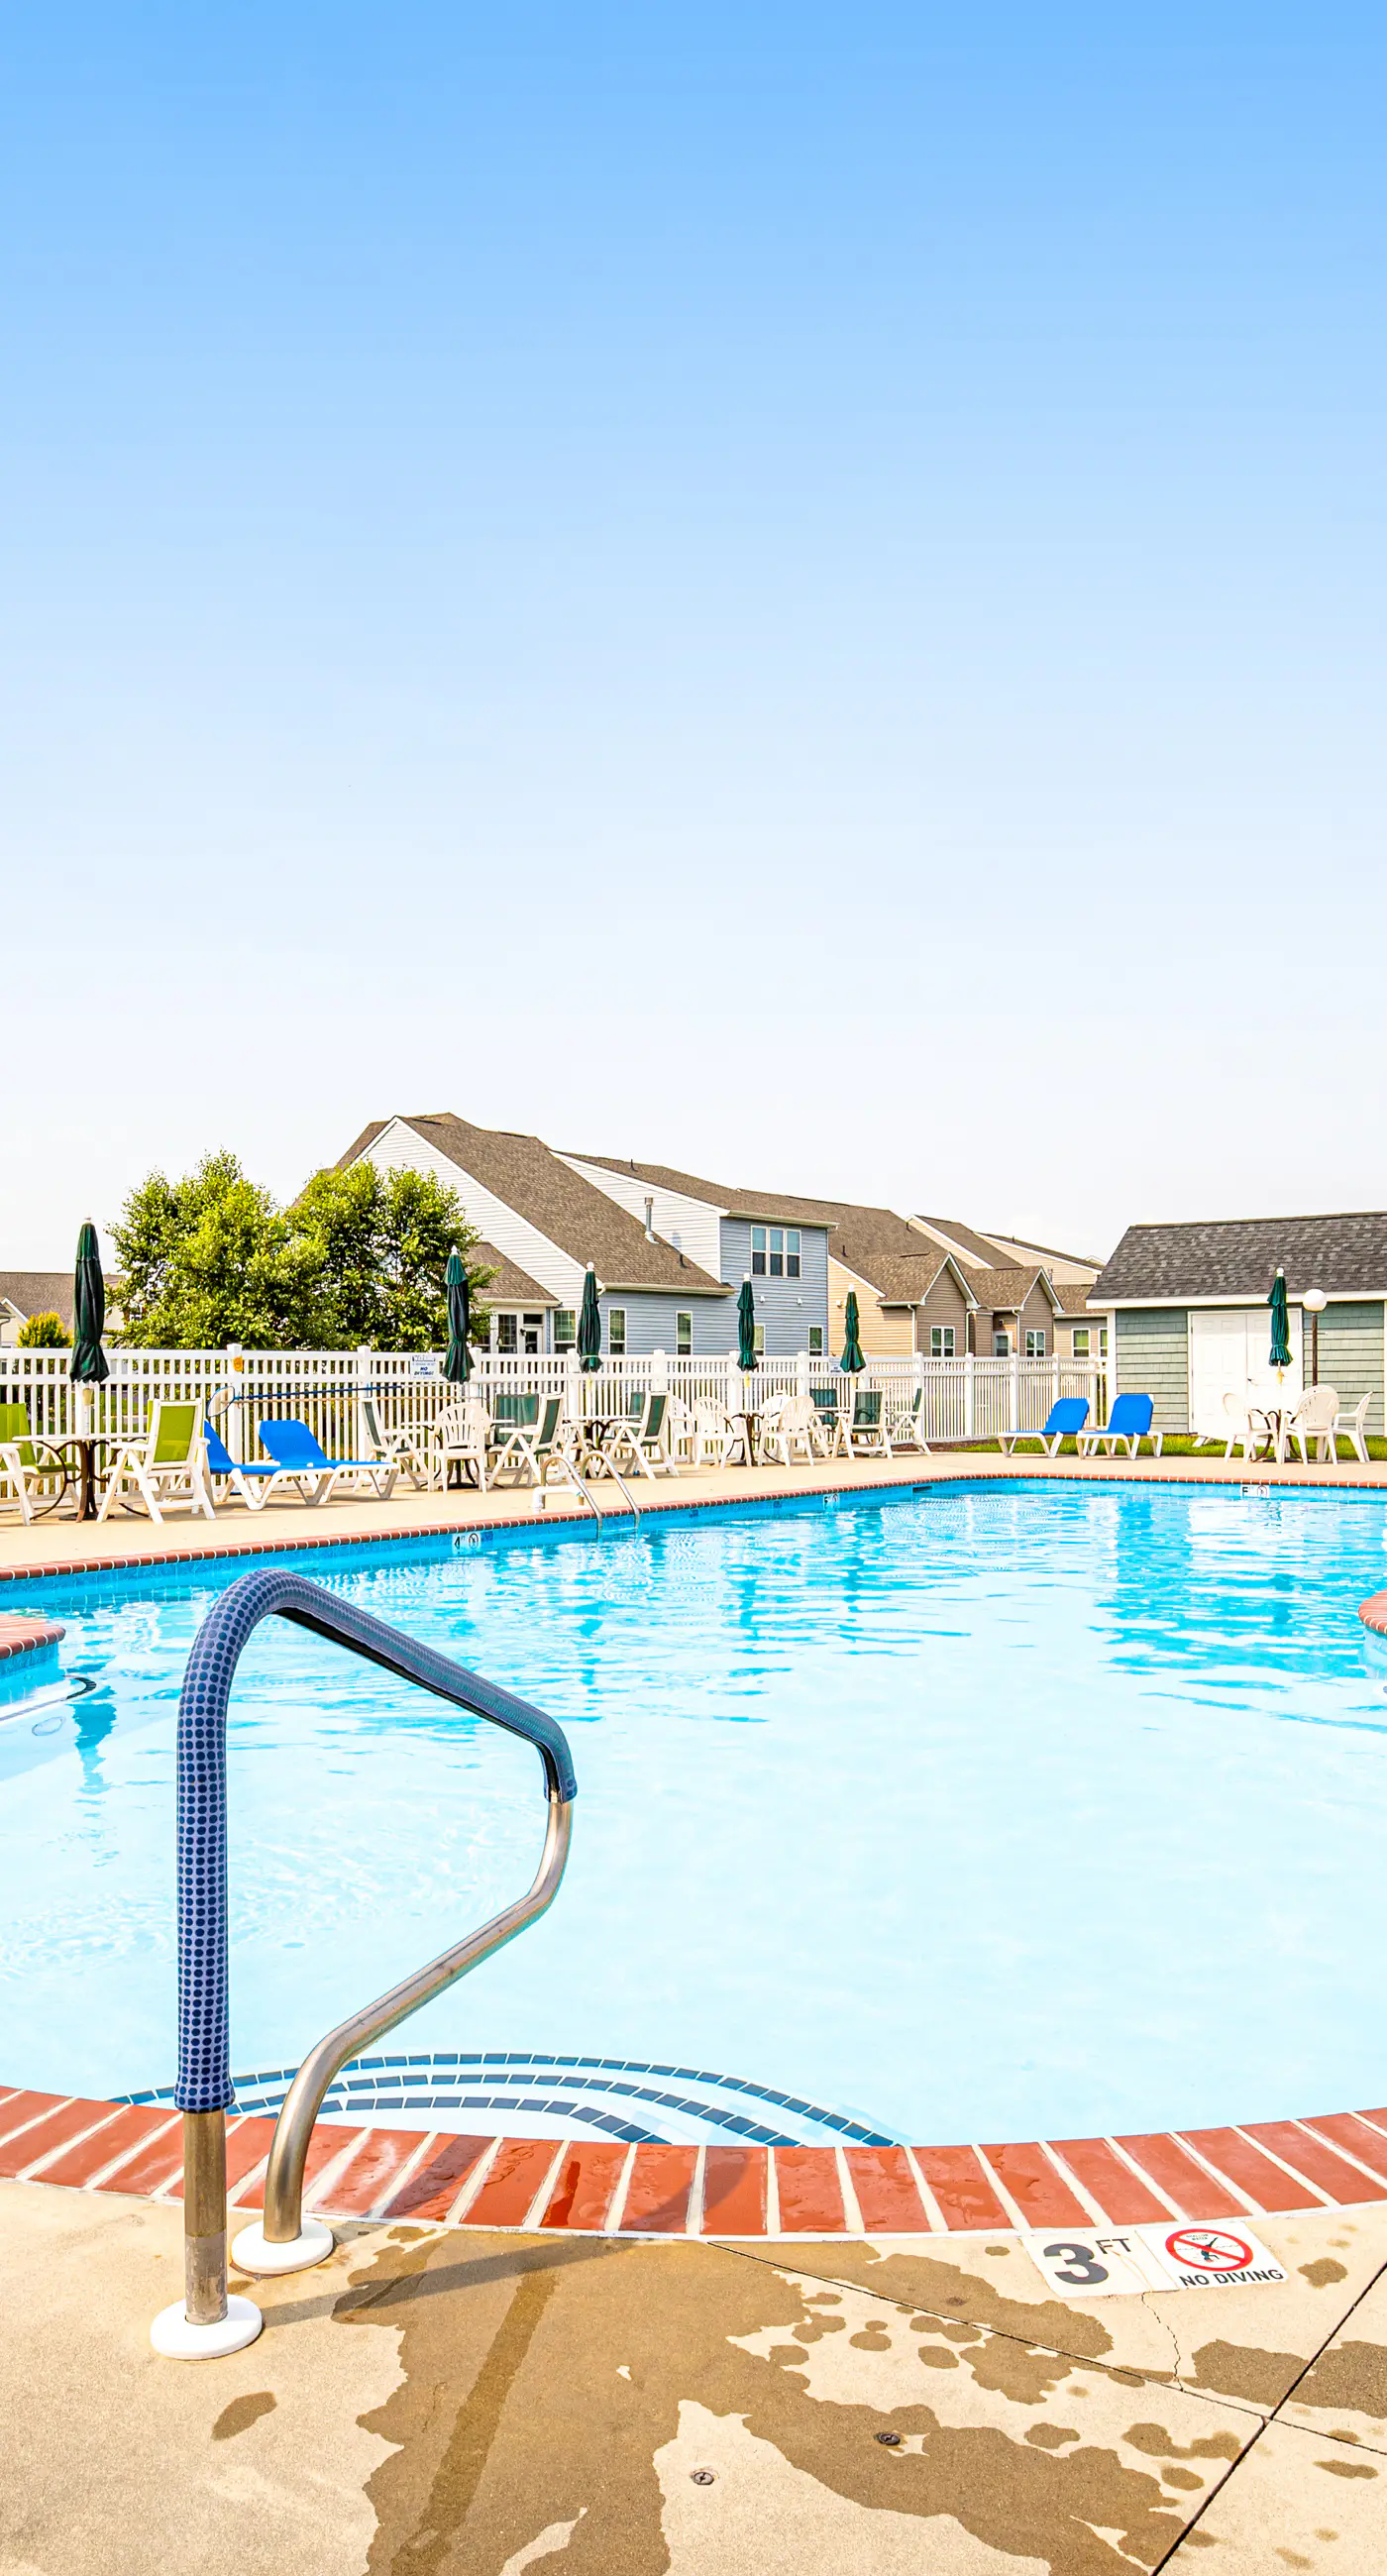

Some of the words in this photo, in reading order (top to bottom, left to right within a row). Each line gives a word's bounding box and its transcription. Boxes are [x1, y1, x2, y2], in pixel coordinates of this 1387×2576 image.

[1043, 2243, 1109, 2285] 3
[1096, 2237, 1132, 2254] FT
[1179, 2275, 1210, 2286] NO
[1213, 2269, 1284, 2284] DIVING
